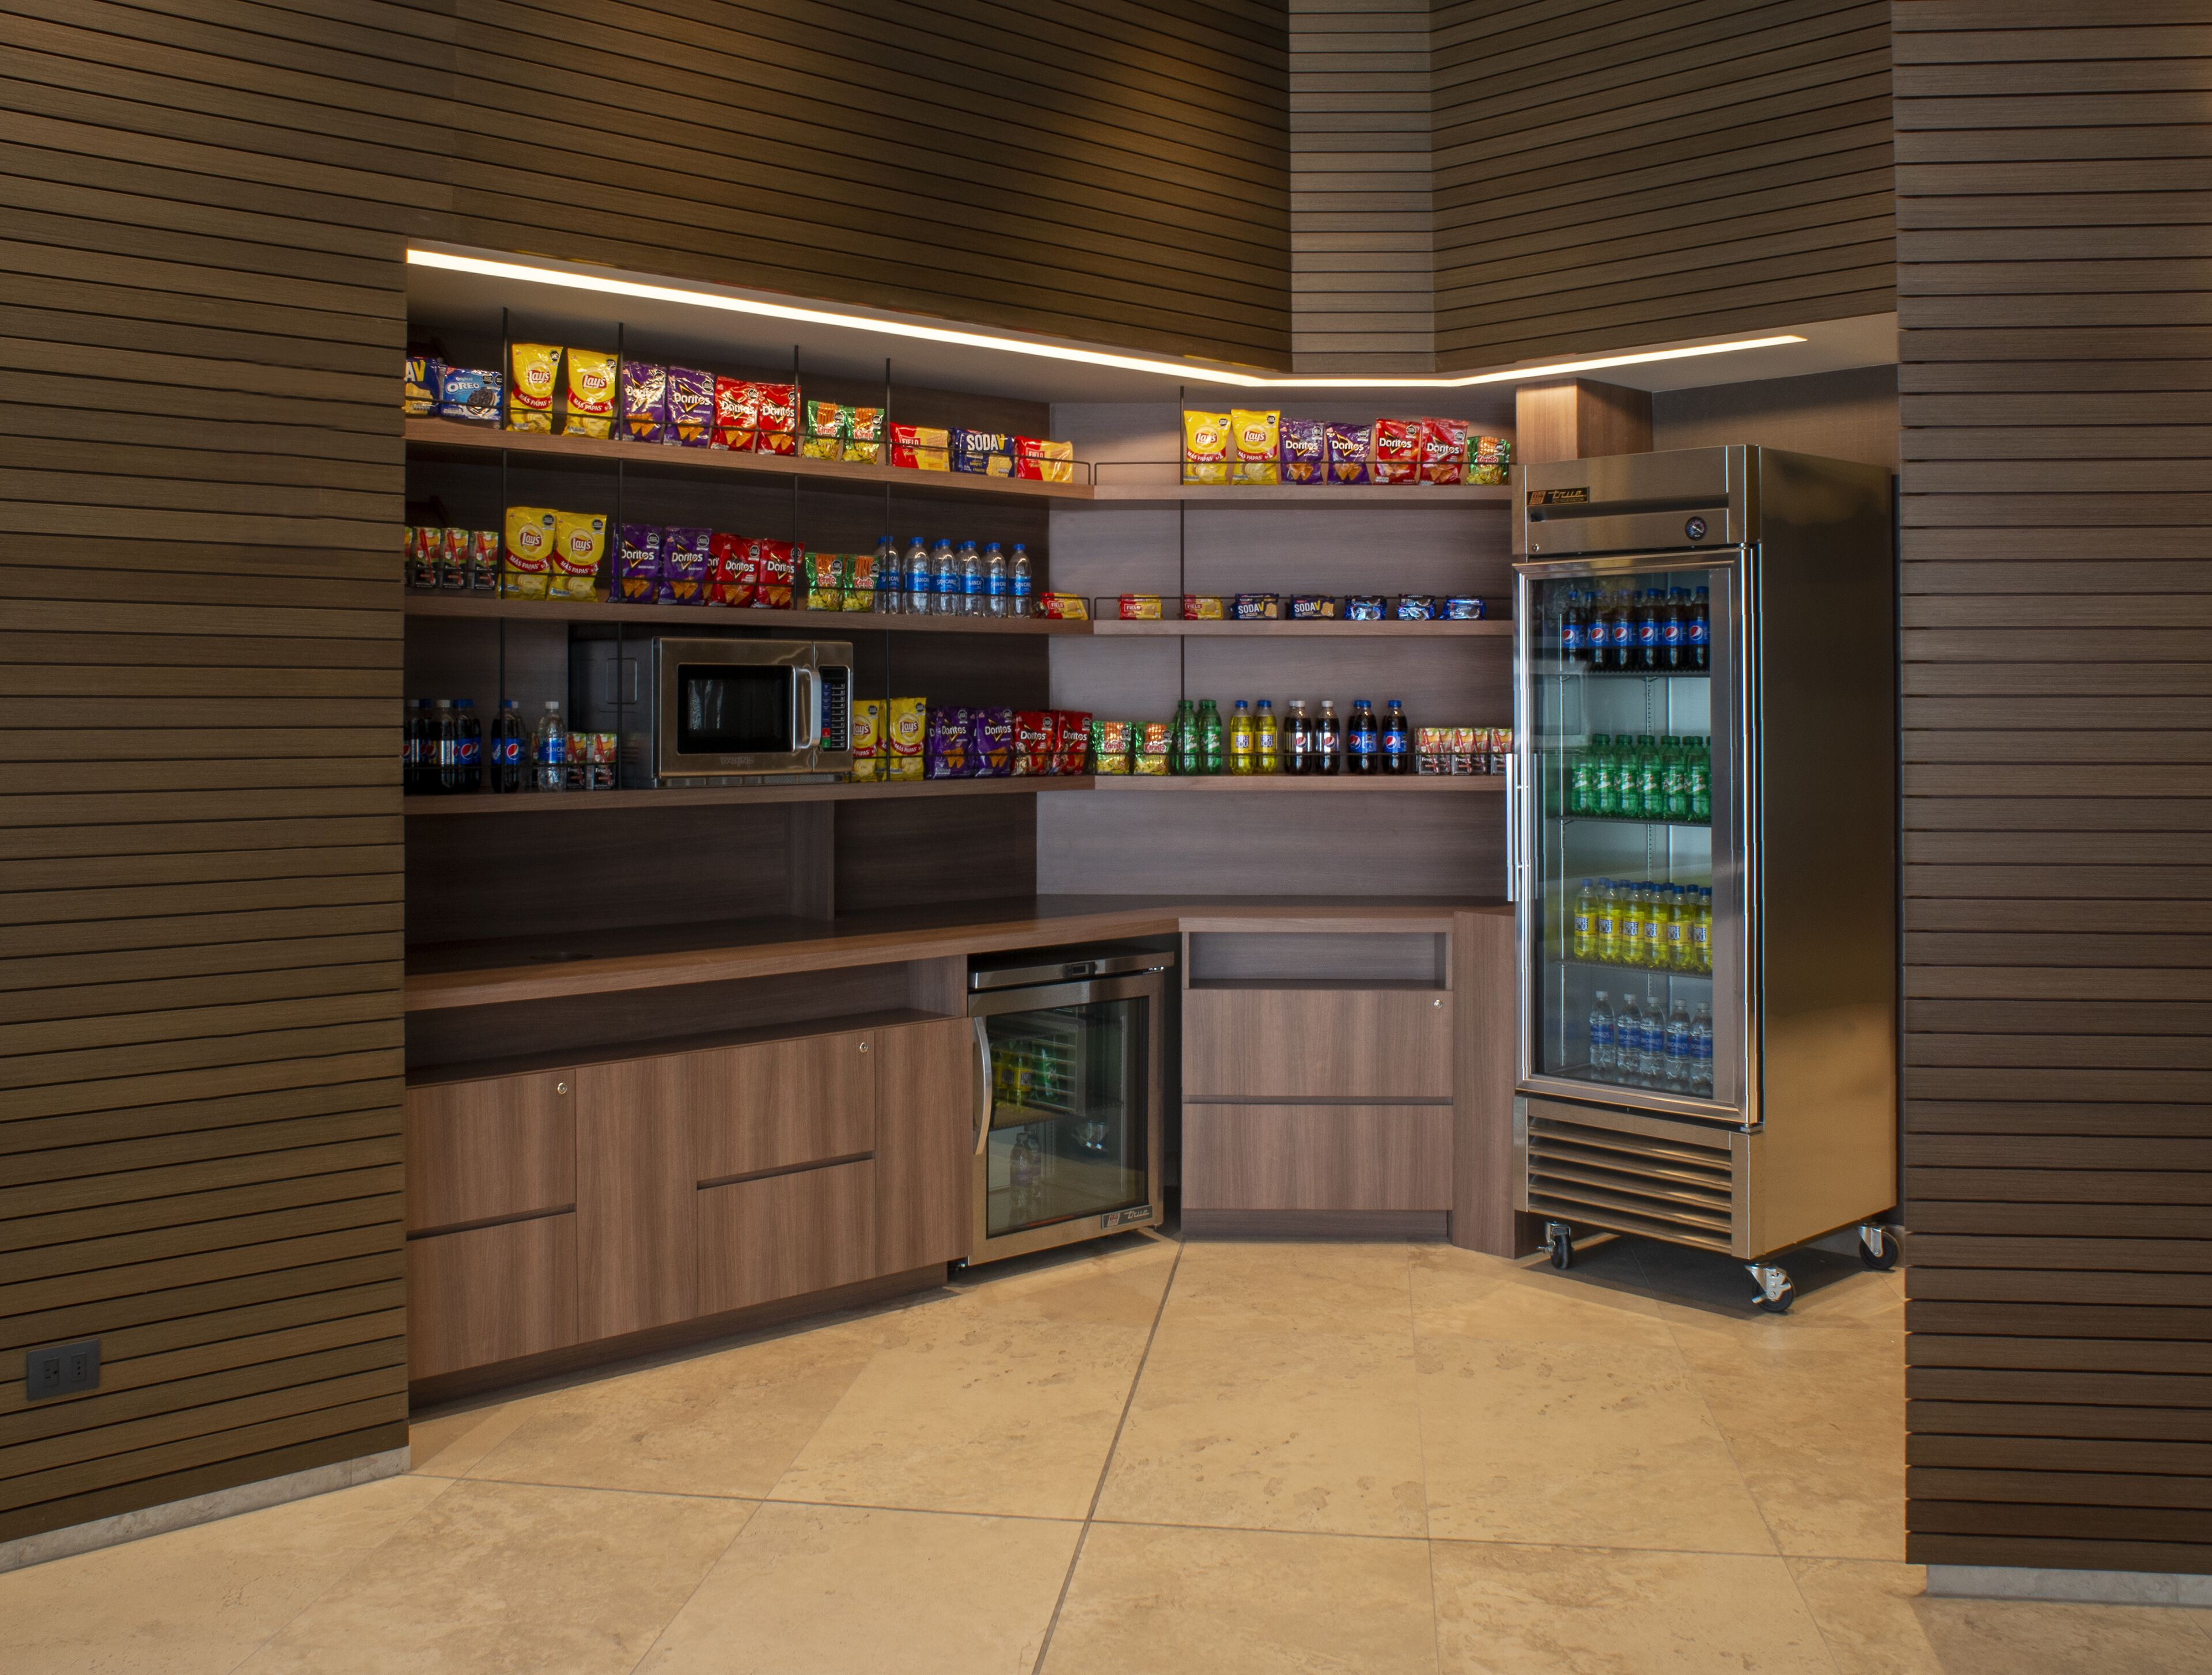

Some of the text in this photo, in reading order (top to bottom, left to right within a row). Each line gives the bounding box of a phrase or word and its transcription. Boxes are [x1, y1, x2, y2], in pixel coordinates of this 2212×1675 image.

[446, 382, 480, 393] OREO
[583, 375, 606, 388] Lay's
[673, 392, 710, 406] Doritos
[1245, 431, 1265, 442] Lay's
[1332, 440, 1364, 451] Doritos
[1379, 437, 1412, 449] Doritos
[1426, 442, 1460, 454] Doritos
[522, 533, 540, 546] Lay's
[573, 539, 592, 551] Lay's
[671, 552, 703, 562] Doritos
[725, 560, 755, 572] Doritos
[767, 561, 795, 574] Doritos
[853, 723, 869, 735] Lay's
[902, 721, 918, 733] Lay's
[941, 726, 967, 734] Doritos
[984, 725, 1012, 735] Doritos
[1020, 730, 1046, 740] Doritos
[1063, 730, 1088, 741] Doritos
